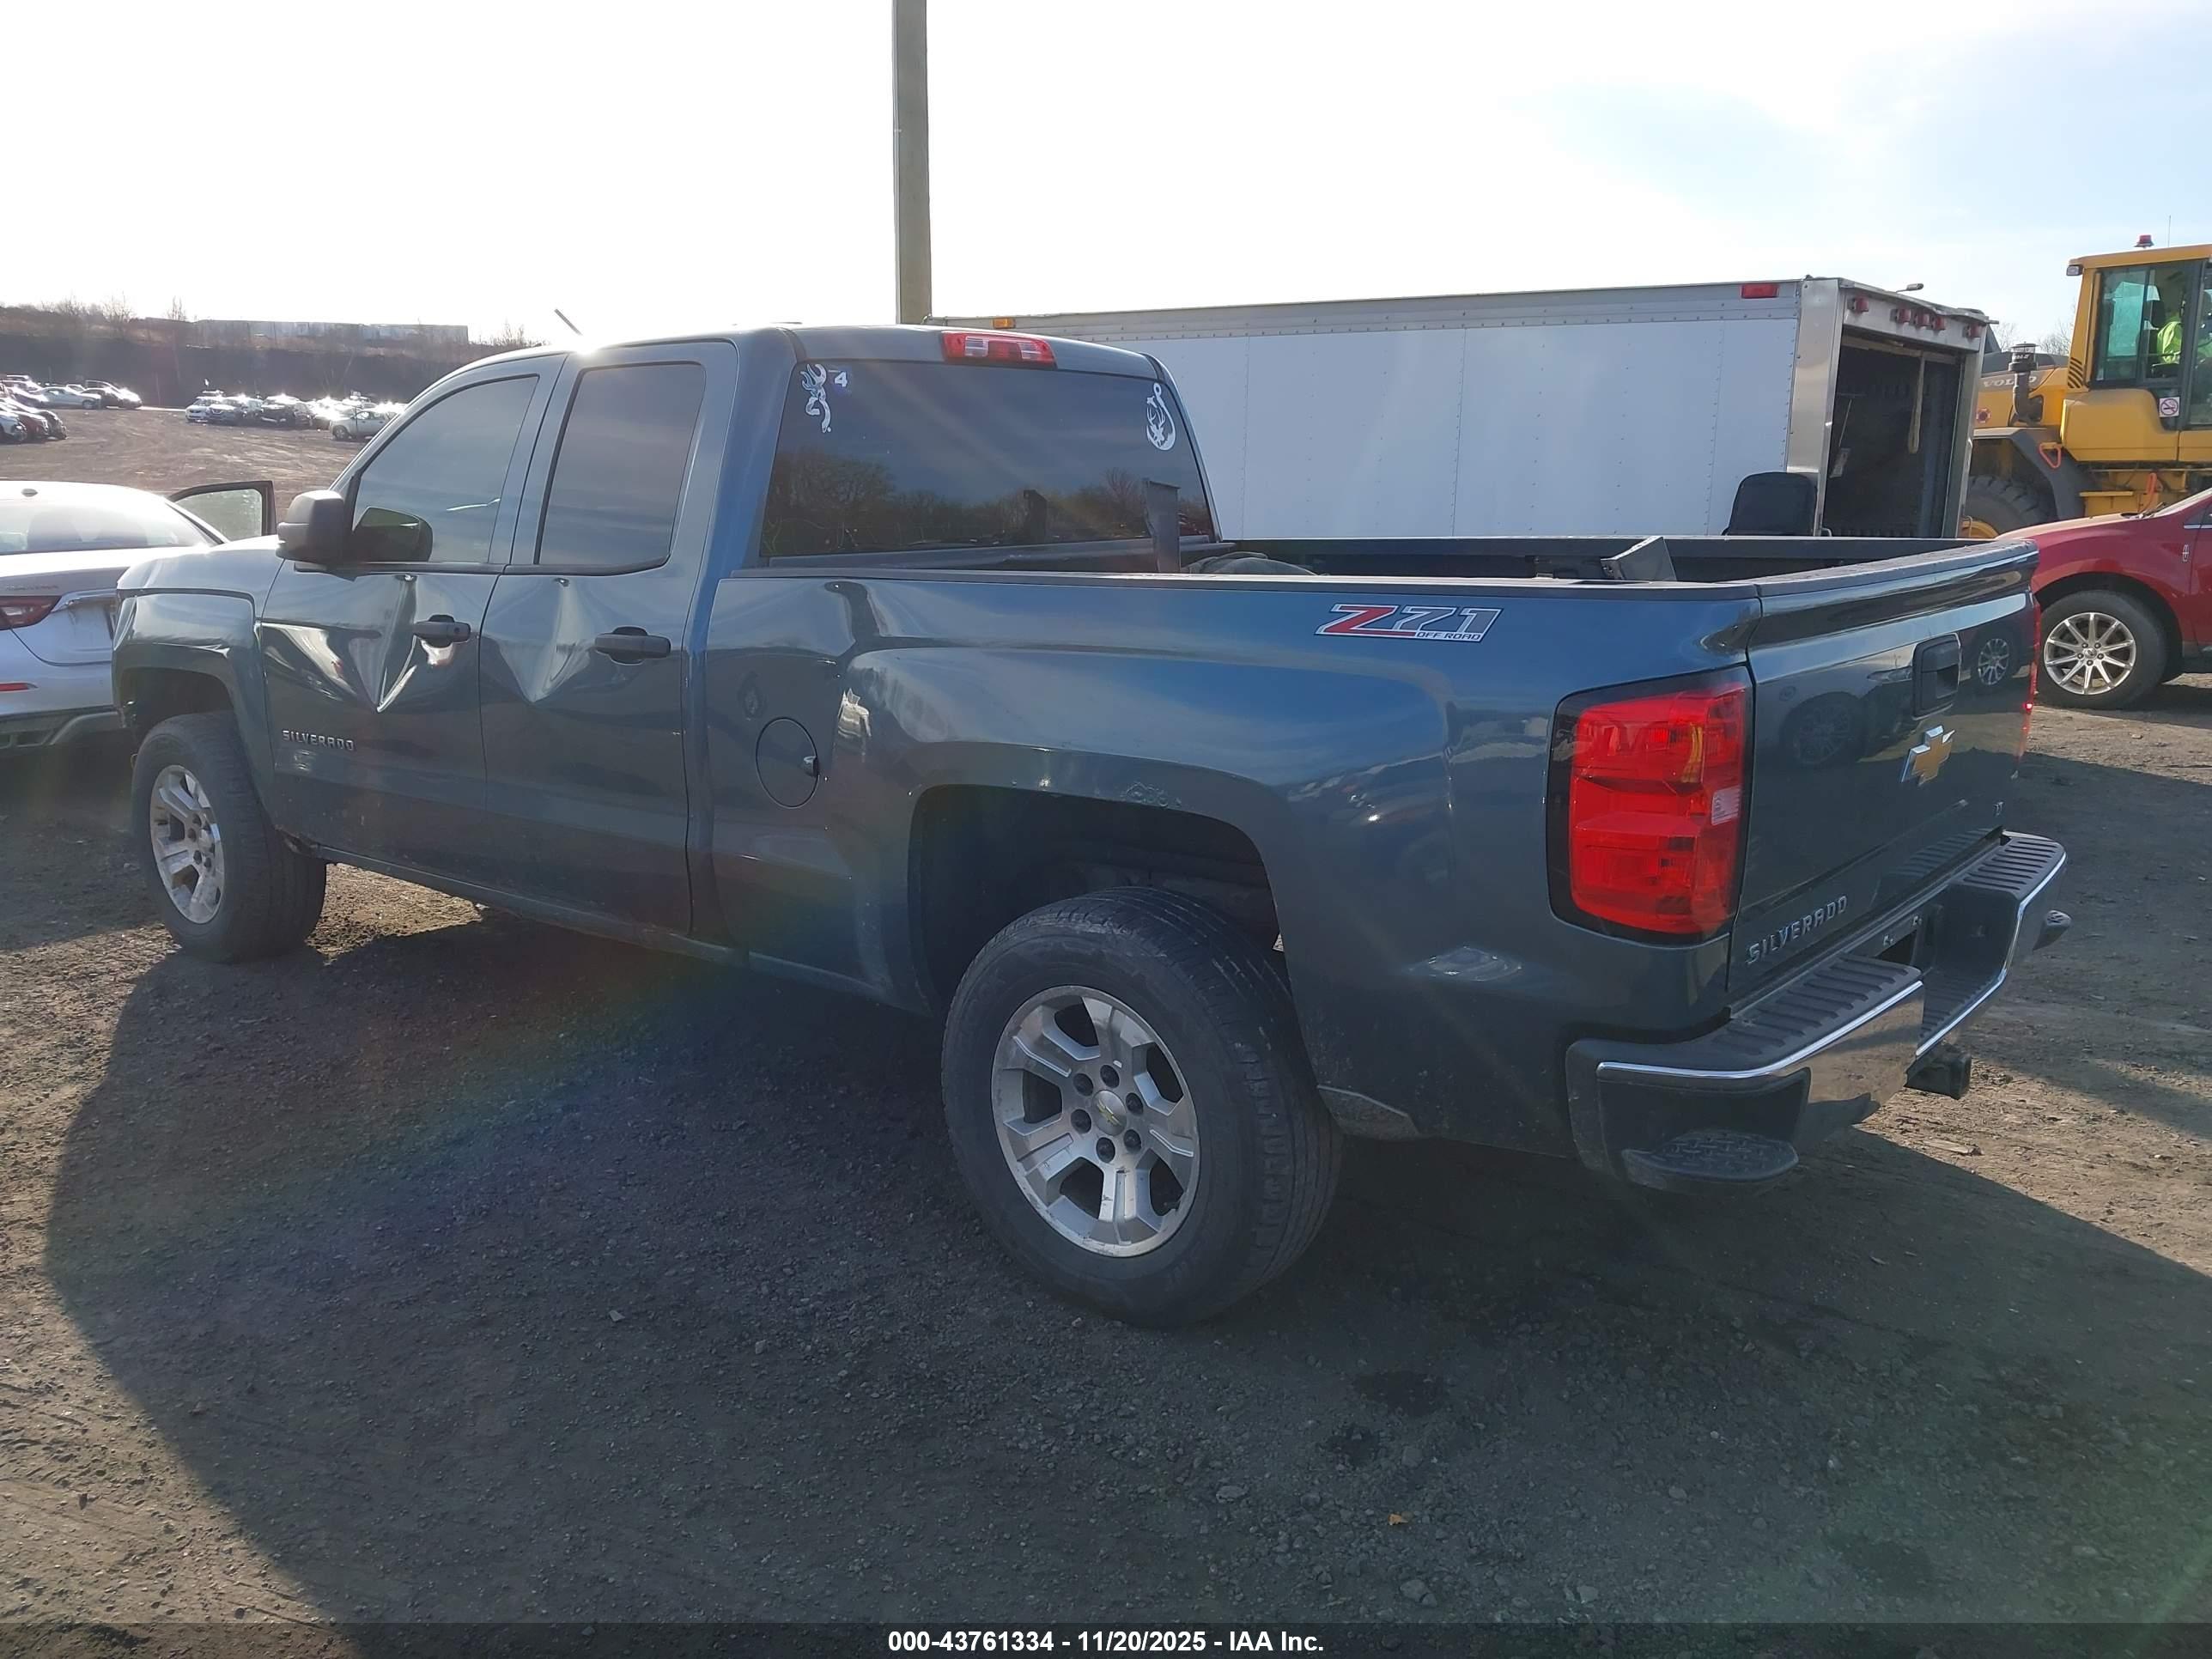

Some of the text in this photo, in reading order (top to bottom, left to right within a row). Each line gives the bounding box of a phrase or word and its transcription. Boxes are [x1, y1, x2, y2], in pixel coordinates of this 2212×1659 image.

[834, 371, 848, 387] 4
[1984, 375, 2037, 387] VOLO
[1315, 603, 1504, 638] Z71
[1416, 631, 1481, 641] OFF ROAD
[282, 730, 355, 751] SILVERADO
[1745, 895, 1848, 965] SILVERADO
